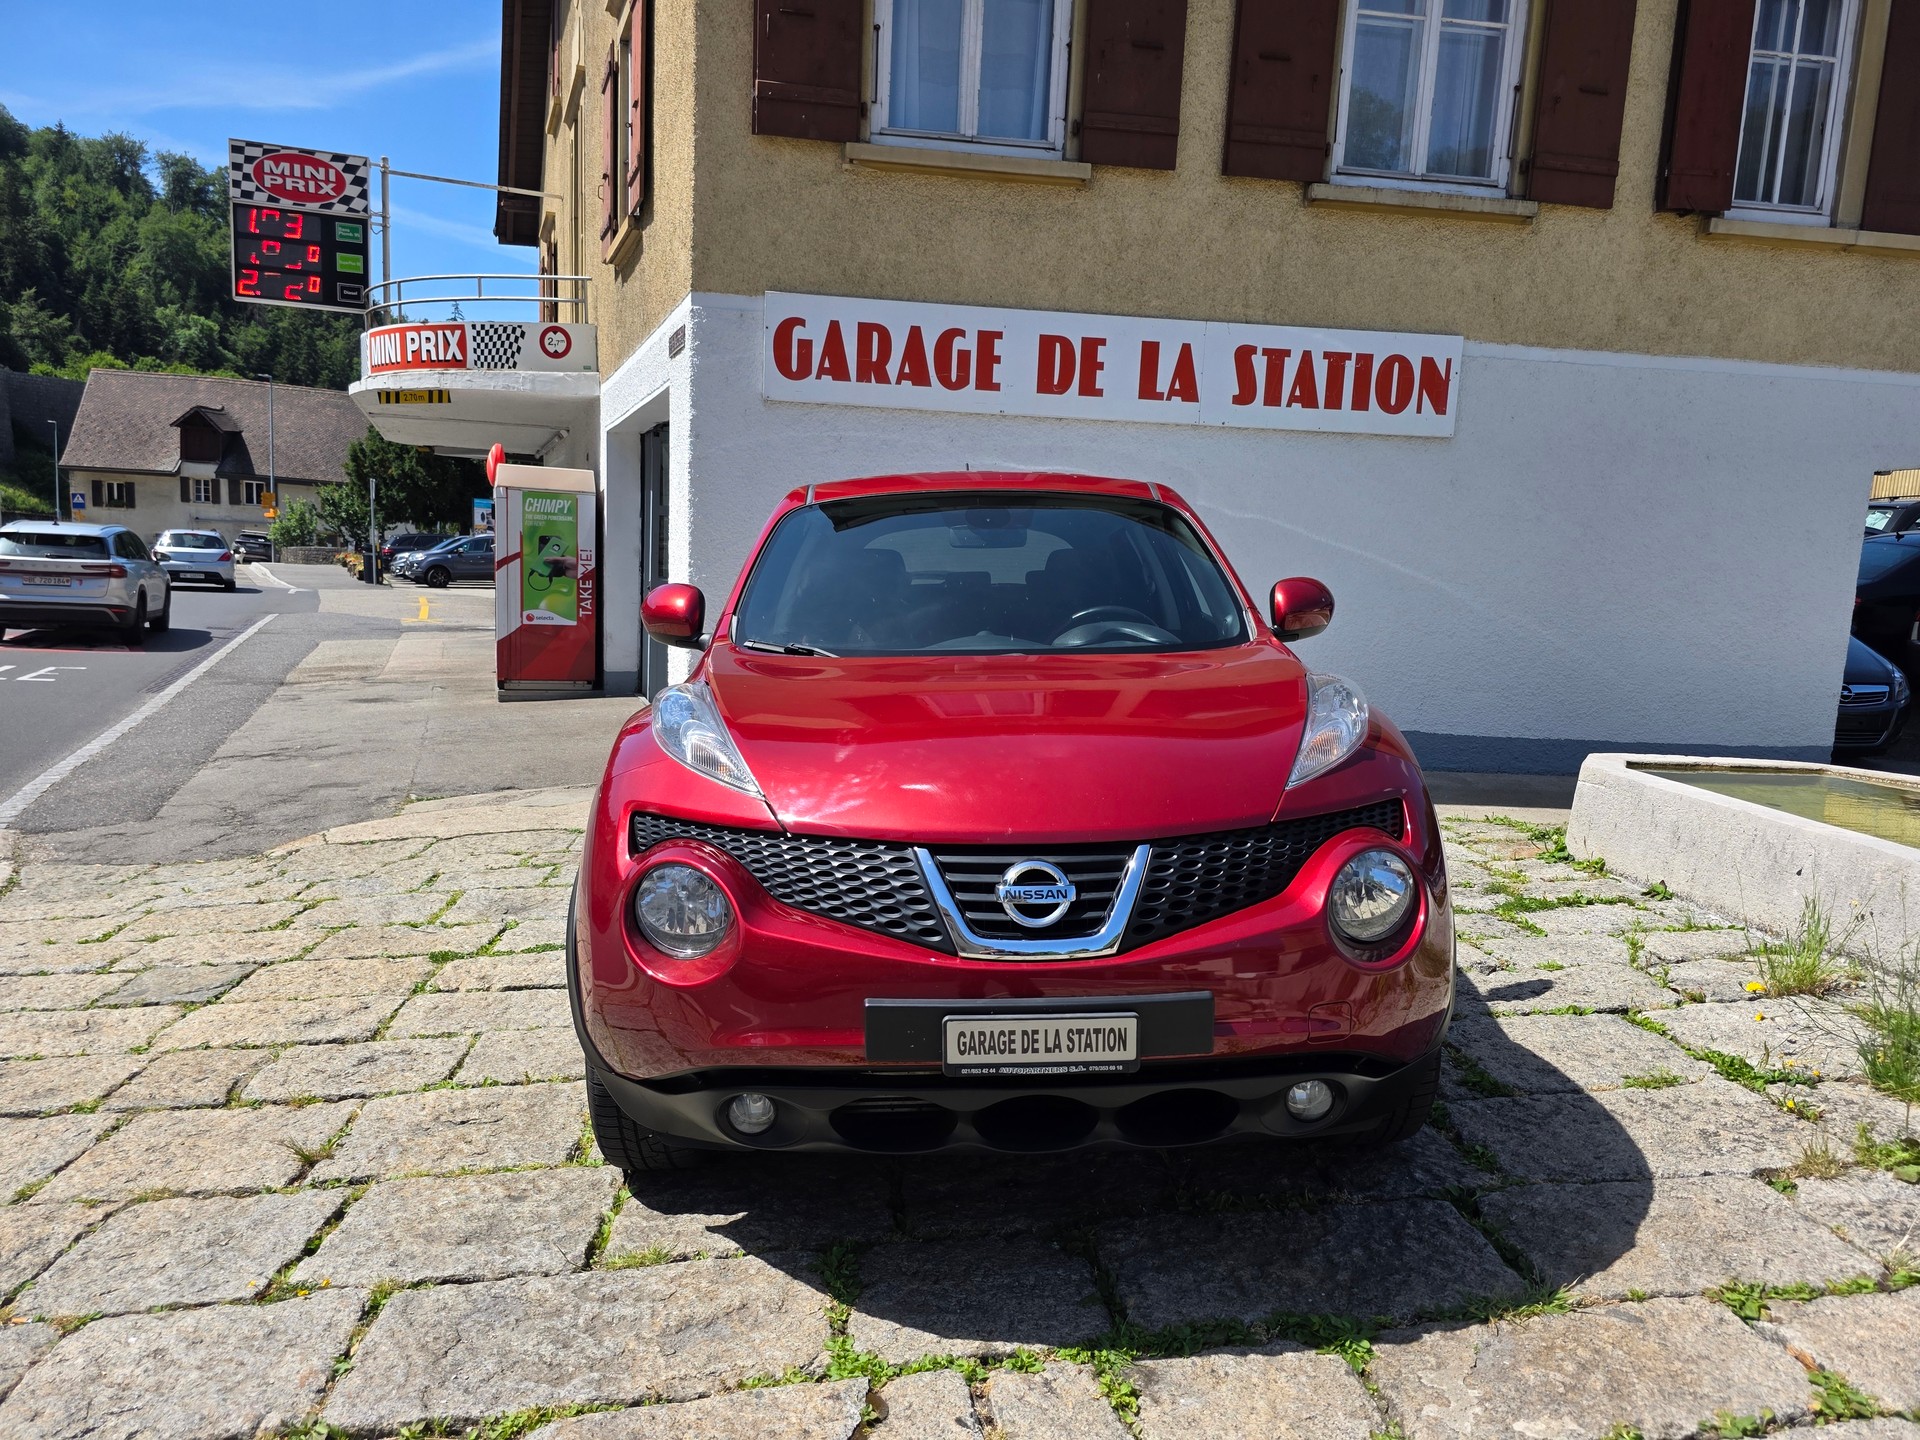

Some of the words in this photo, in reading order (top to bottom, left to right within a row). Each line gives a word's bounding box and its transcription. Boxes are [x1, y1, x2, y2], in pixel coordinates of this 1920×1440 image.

[263, 160, 336, 182] MINI
[263, 175, 338, 196] PRIX
[370, 332, 401, 368] MINI
[405, 329, 464, 363] PRIX
[772, 316, 1004, 392] GARAGE
[1036, 333, 1108, 398] DE
[1137, 340, 1200, 403] LA
[1230, 343, 1452, 416] STATION
[524, 497, 572, 514] CHIMPY
[579, 549, 592, 576] ME!
[579, 579, 592, 618] TAKE
[1004, 889, 1068, 900] NISSAN
[957, 1030, 1017, 1056] GARAGE
[1021, 1029, 1040, 1054] DE
[1044, 1028, 1063, 1053] LA
[1066, 1027, 1127, 1053] STATION
[998, 1066, 1068, 1075] AUTOPARTNERS
